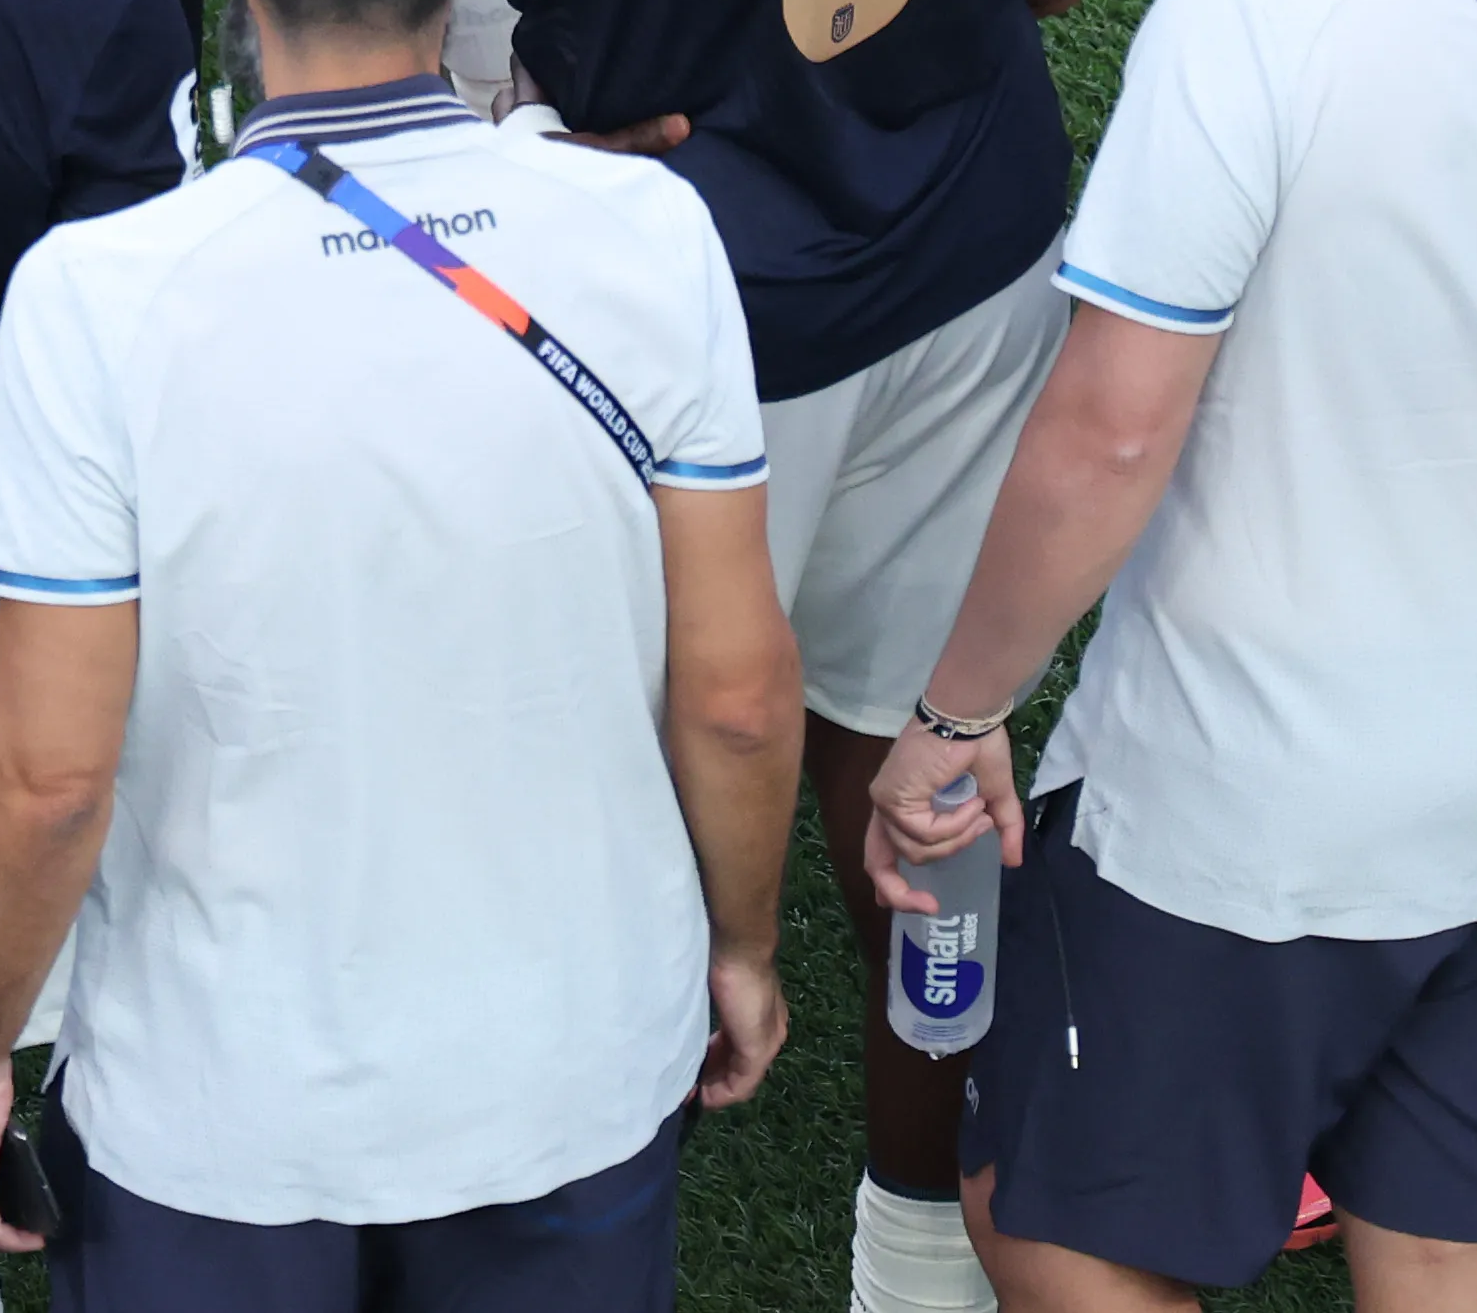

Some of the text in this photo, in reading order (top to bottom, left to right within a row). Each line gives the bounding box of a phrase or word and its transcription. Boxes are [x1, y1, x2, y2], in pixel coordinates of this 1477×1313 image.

[537, 338, 648, 466] FIFA WORLD CUP
[924, 914, 961, 1006] smart
[962, 912, 979, 955] water
